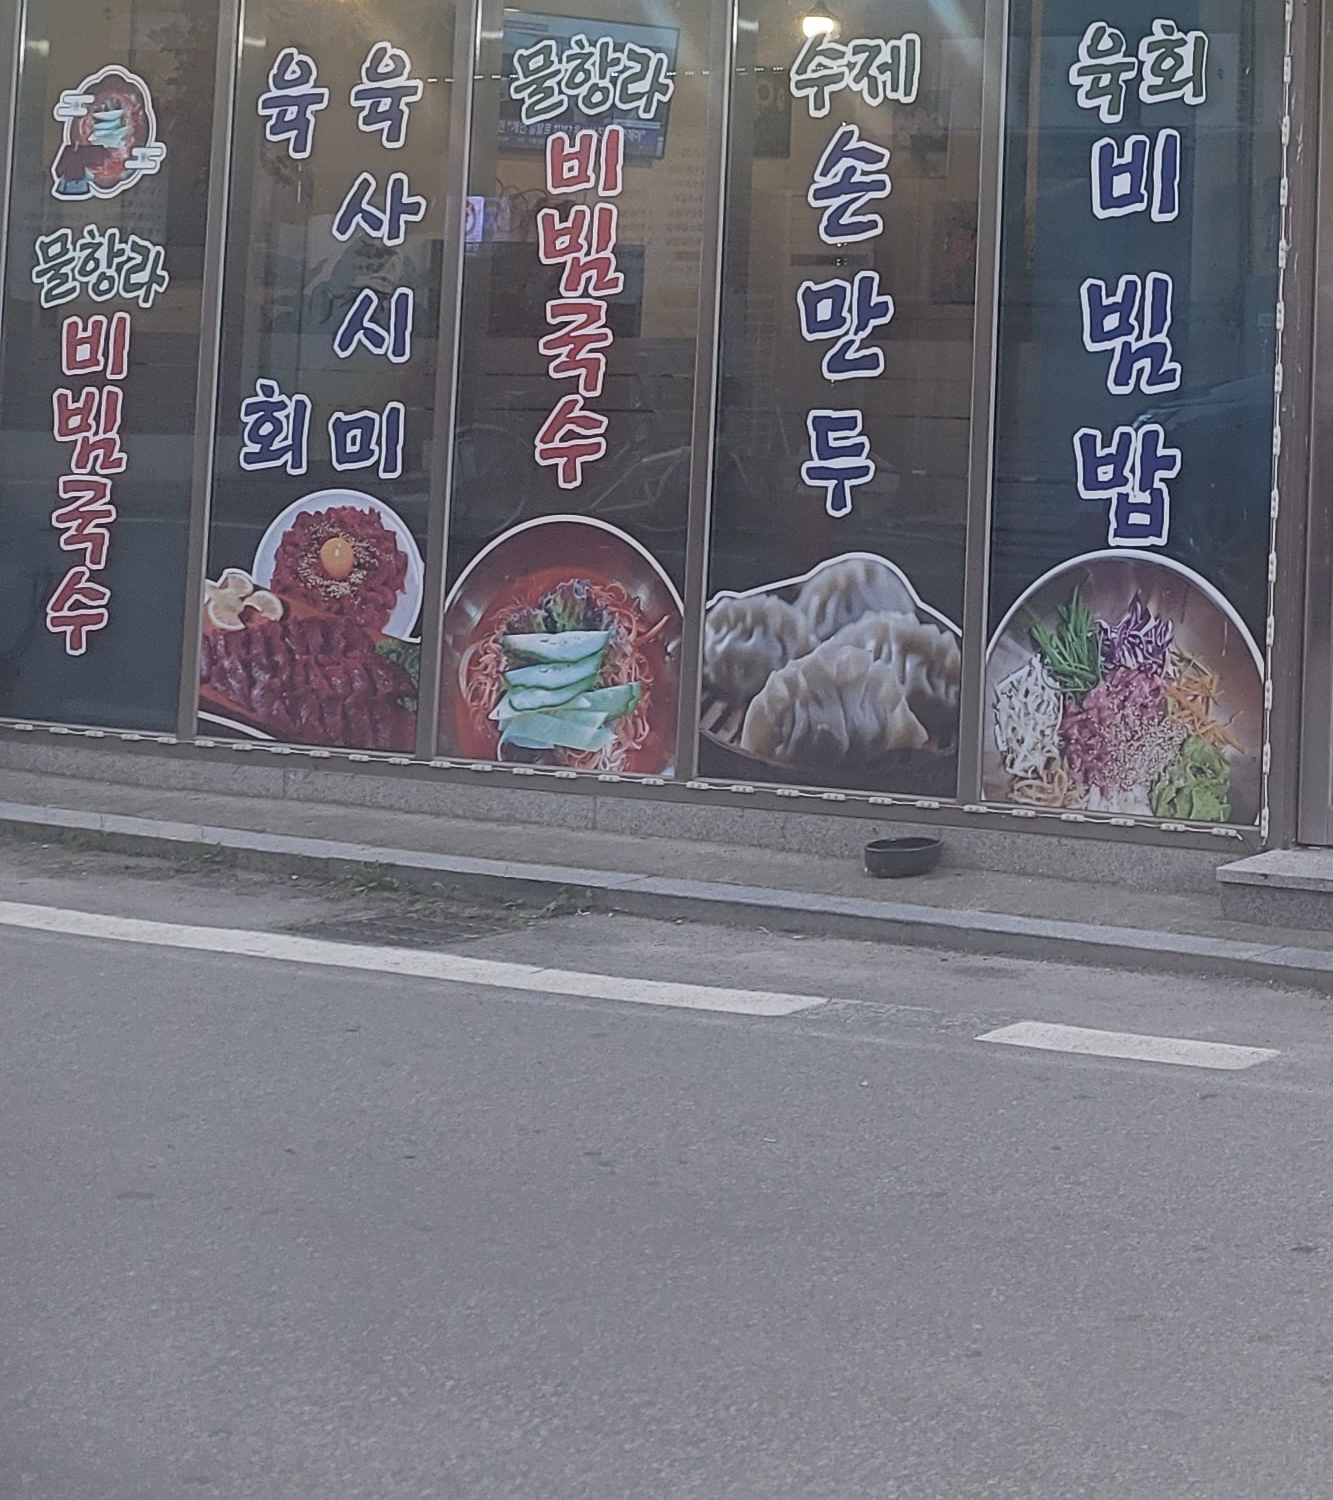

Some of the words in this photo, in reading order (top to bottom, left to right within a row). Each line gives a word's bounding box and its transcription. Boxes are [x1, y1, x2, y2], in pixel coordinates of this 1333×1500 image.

[510, 33, 674, 125] 물항라
[790, 33, 921, 117] 수제
[1070, 19, 1208, 124] 육회
[32, 224, 168, 307] 물항라
[534, 125, 624, 488] 비빔국수
[798, 123, 894, 516] 손만두
[1073, 129, 1181, 546] 비빔밥
[46, 312, 130, 655] 비빔국수
